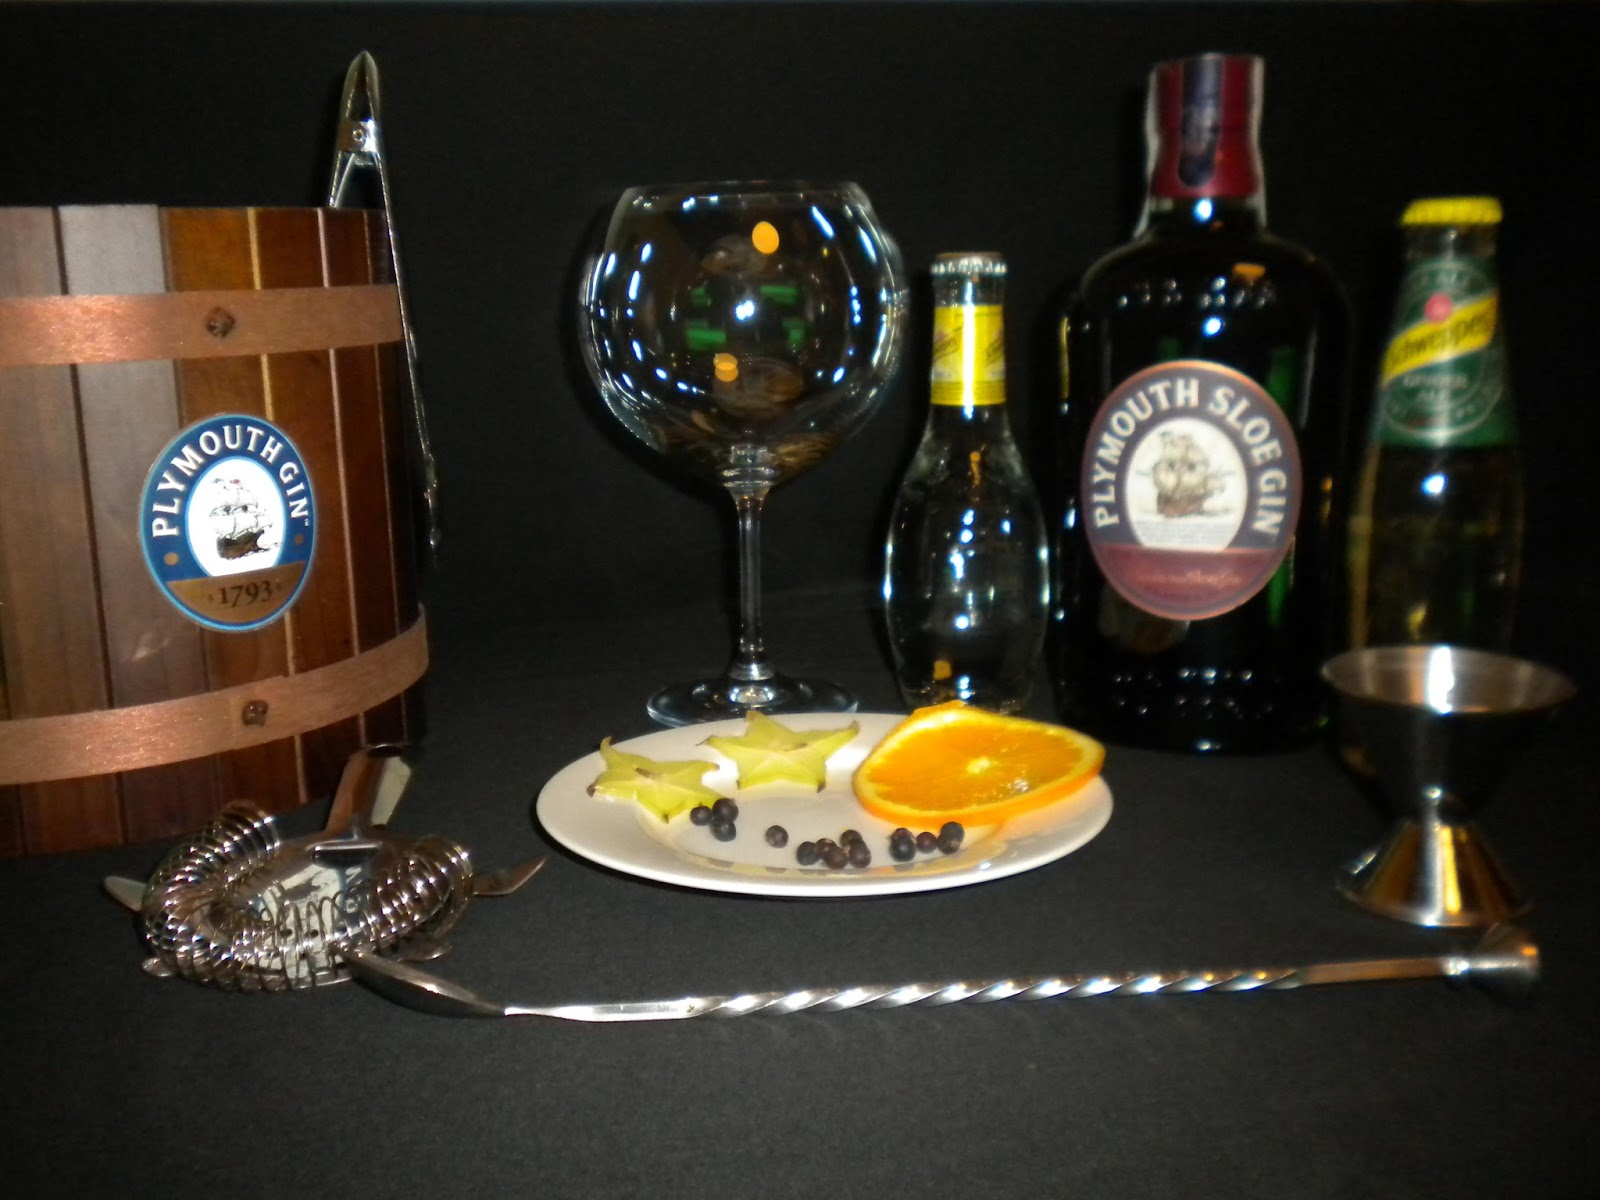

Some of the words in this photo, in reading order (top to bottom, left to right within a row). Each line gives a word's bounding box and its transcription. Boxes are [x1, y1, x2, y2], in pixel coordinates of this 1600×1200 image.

[152, 424, 284, 537] PLYMOUTH
[1093, 378, 1199, 528] PLYMOUTH
[1209, 385, 1283, 467] SLOE
[1252, 468, 1288, 536] GIN
[219, 580, 273, 608] 1793
